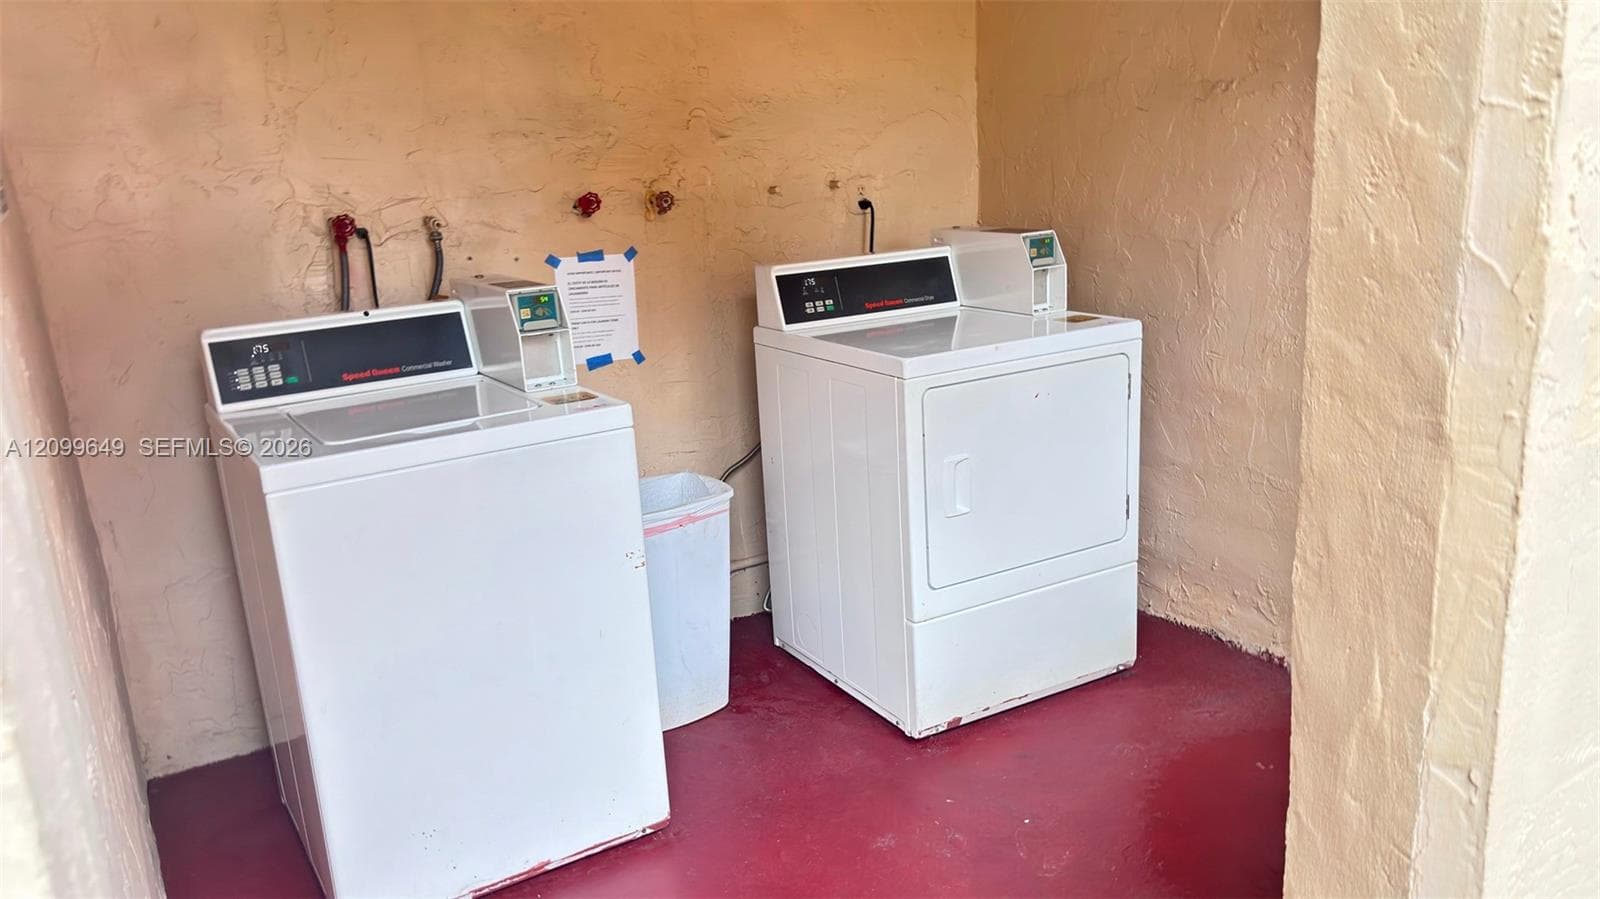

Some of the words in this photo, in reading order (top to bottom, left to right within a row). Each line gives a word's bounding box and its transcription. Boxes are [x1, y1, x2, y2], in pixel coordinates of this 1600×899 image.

[342, 369, 371, 381] Speed
[371, 366, 401, 376] Queen
[401, 363, 433, 373] Commercial
[433, 360, 453, 368] Washer
